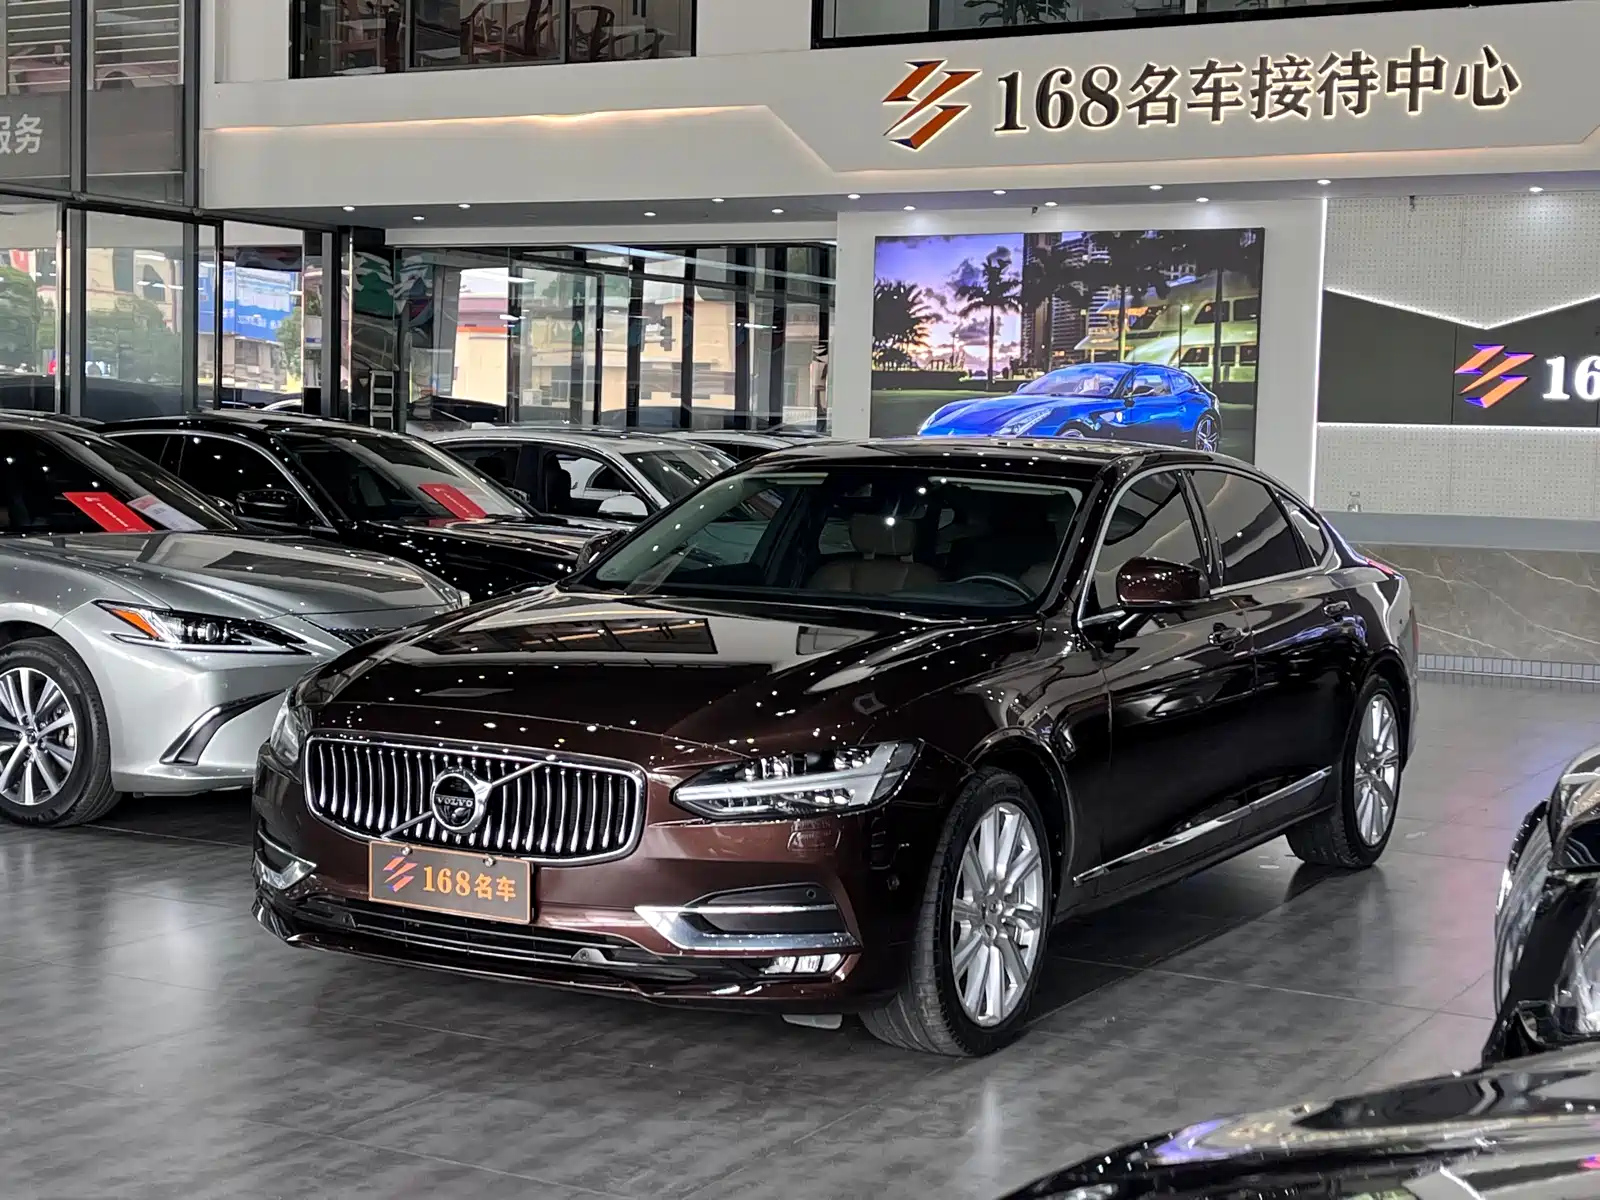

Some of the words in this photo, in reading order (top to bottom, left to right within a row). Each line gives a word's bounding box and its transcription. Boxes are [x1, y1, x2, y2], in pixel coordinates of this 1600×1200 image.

[994, 45, 1520, 133] 168名车接待中心
[437, 796, 473, 807] VOLVO
[423, 865, 516, 902] 168名车
